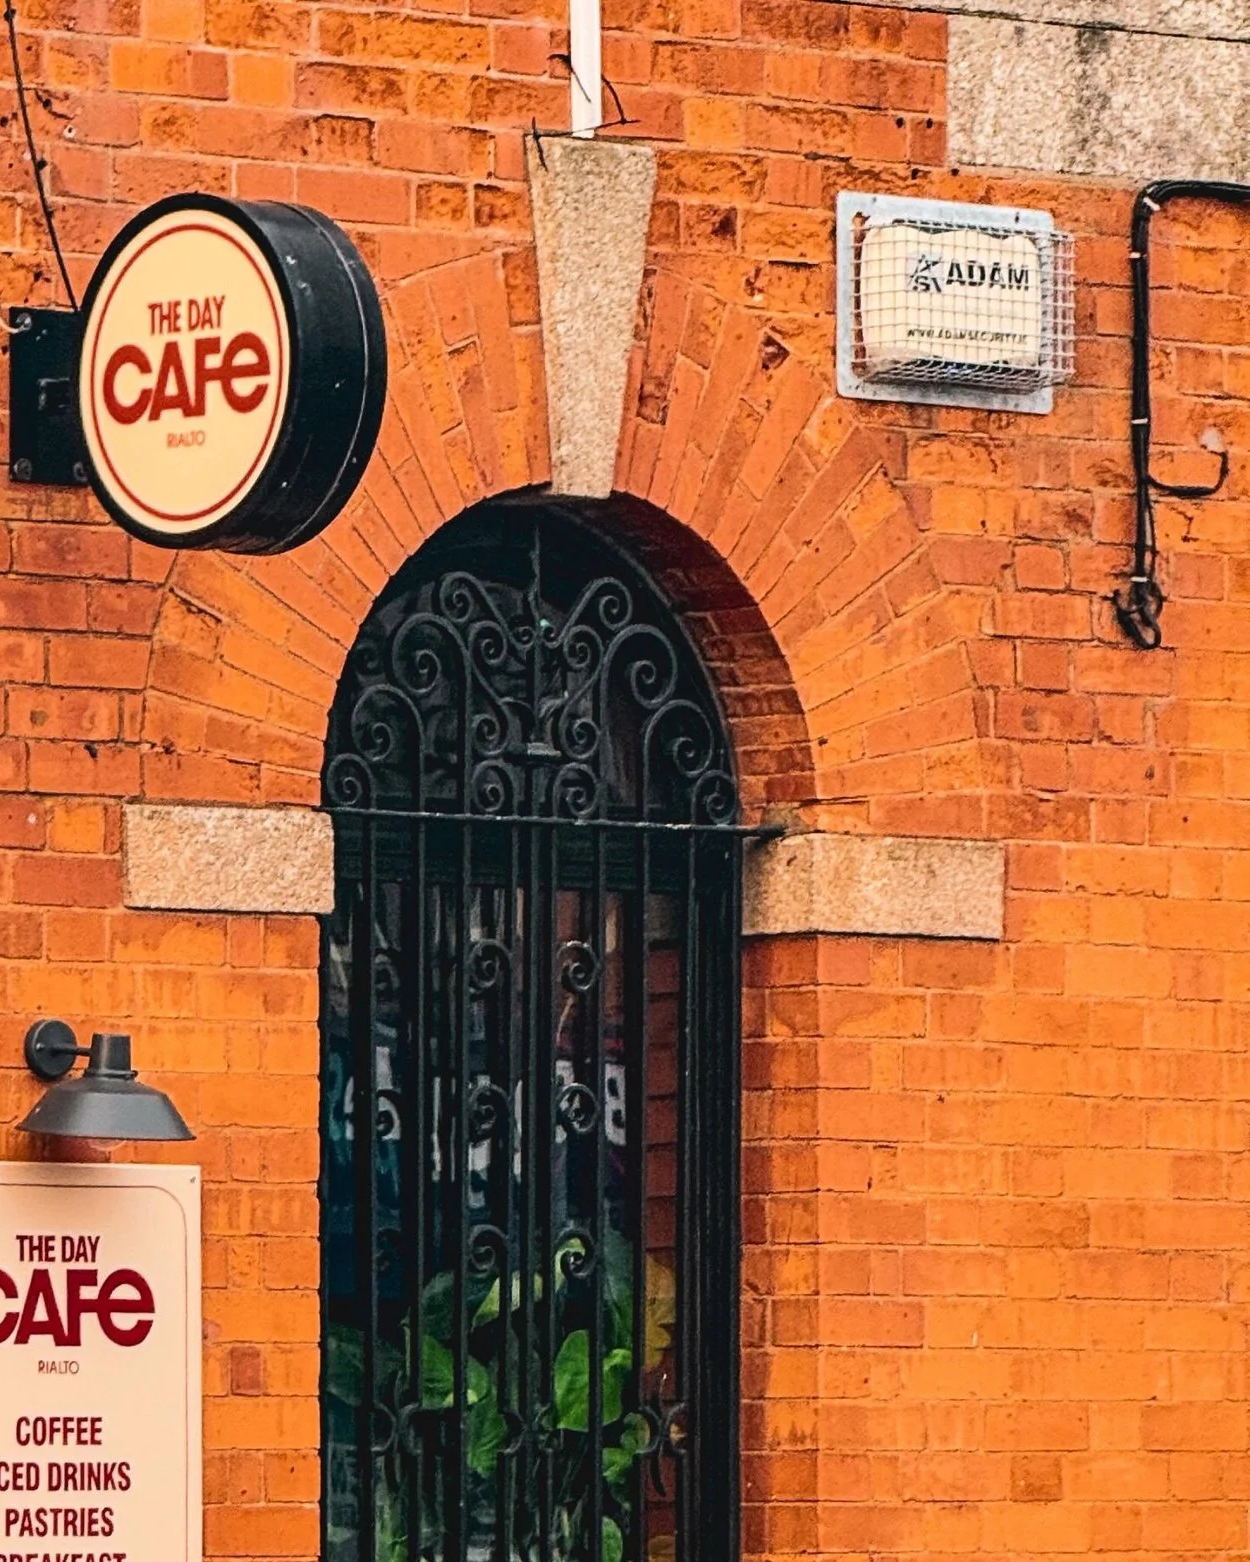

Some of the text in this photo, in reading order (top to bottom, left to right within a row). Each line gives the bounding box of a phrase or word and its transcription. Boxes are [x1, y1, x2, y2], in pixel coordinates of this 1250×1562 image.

[946, 260, 1029, 291] ADAM
[148, 295, 226, 336] THE DAY
[166, 430, 206, 449] RIALTO
[15, 1235, 101, 1263] THE DAY
[37, 1360, 80, 1375] RIALTO
[15, 1416, 103, 1446] COFFEE
[47, 1461, 132, 1491] DRINKS
[4, 1507, 115, 1538] PASTRIES
